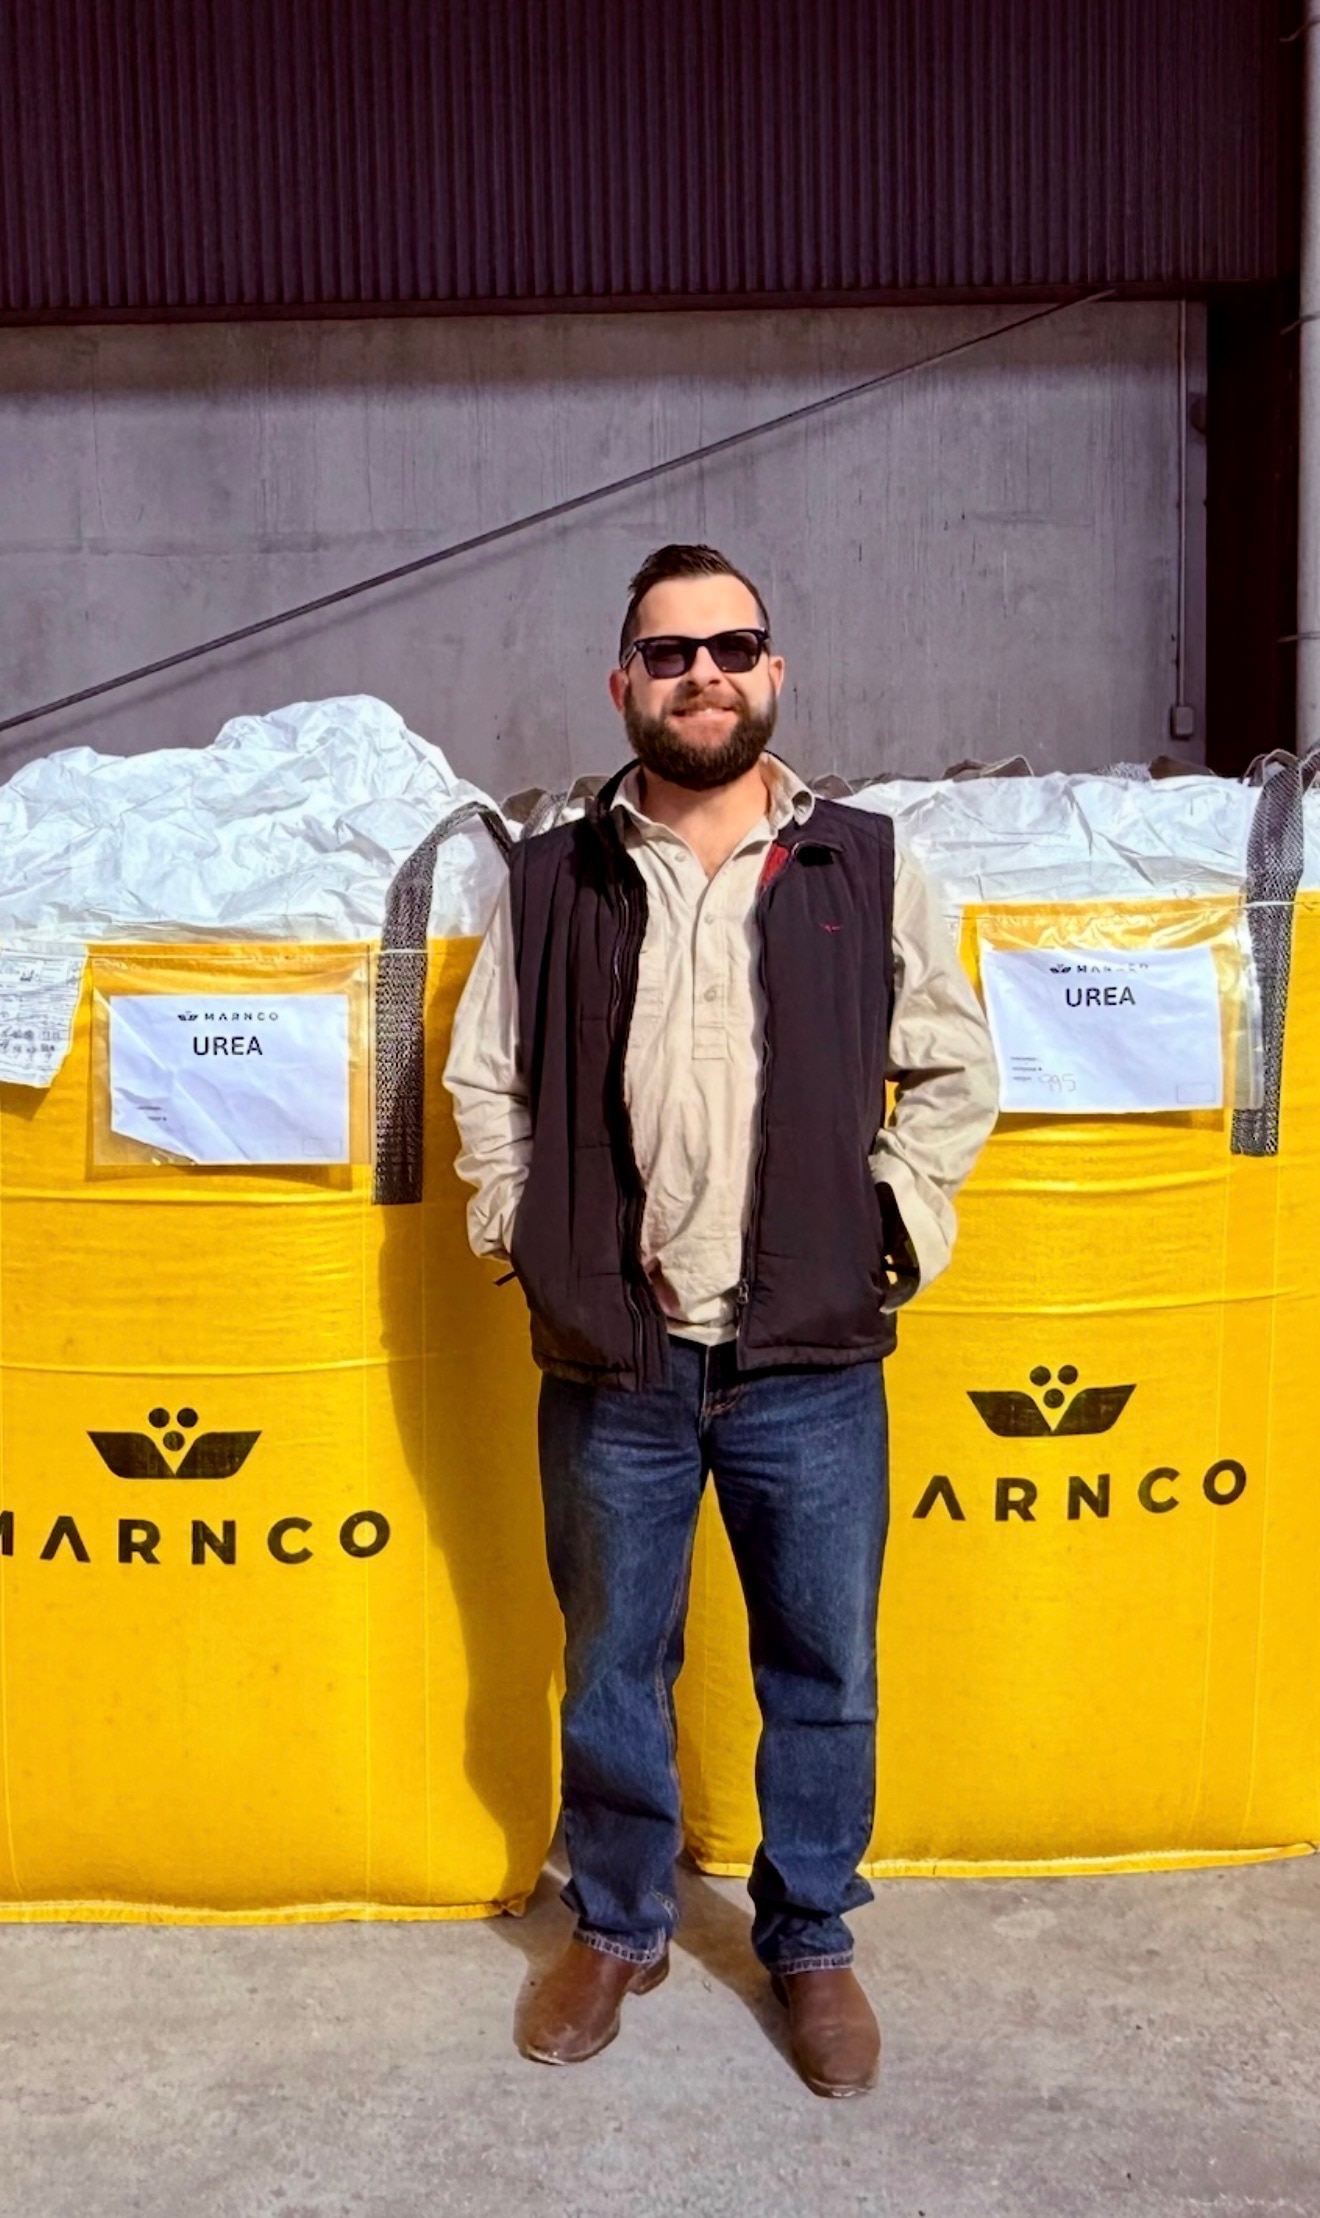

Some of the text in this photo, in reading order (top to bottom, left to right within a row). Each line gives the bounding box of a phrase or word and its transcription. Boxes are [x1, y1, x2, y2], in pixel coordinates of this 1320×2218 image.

[1065, 986, 1136, 1007] UREA
[204, 1012, 279, 1021] MARNCO
[193, 1036, 263, 1056] UREA
[912, 1458, 1247, 1522] ARNCO
